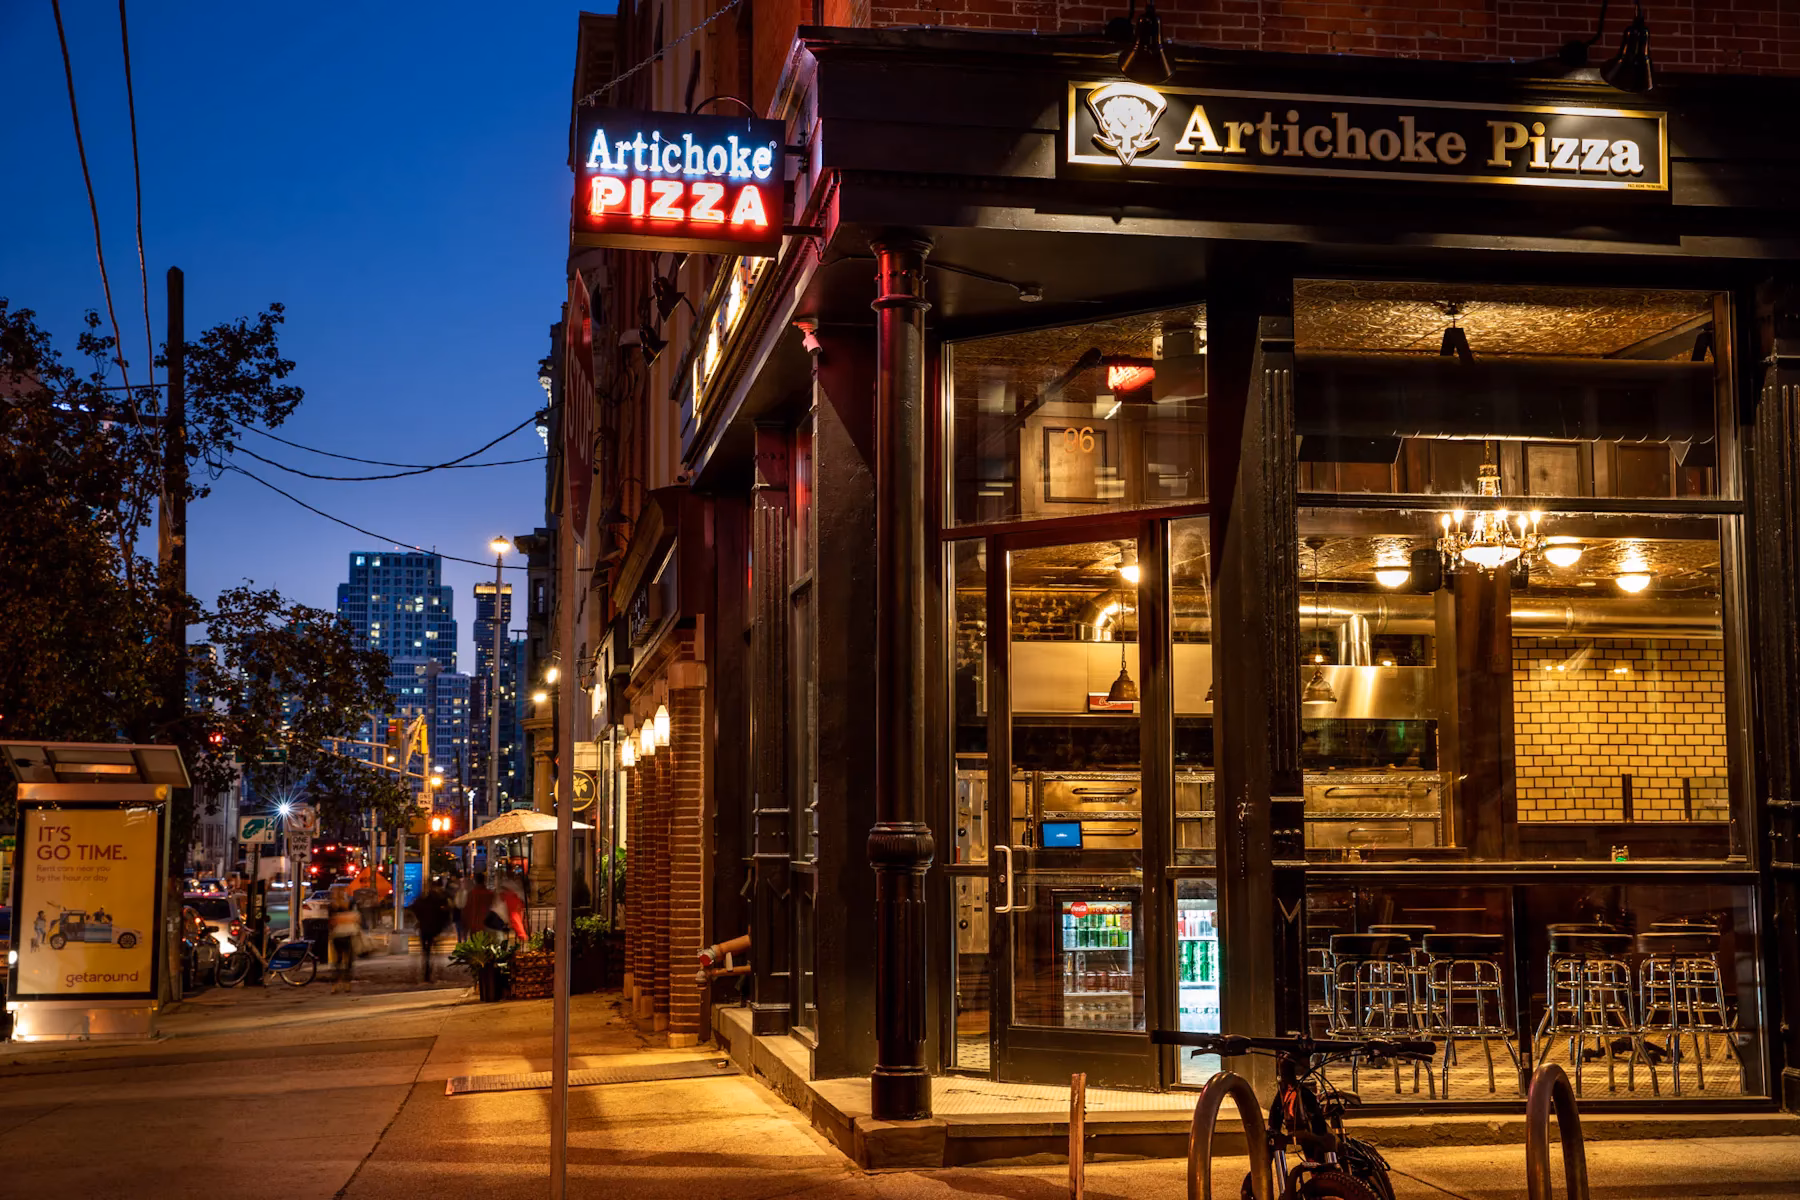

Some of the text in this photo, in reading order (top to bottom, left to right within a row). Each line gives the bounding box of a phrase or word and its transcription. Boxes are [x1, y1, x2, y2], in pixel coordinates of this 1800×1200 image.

[1175, 104, 1645, 176] Artichoke Pizza
[586, 128, 774, 179] Artichoke
[591, 175, 769, 227] PIZZA
[567, 346, 593, 466] STOP
[1063, 426, 1095, 453] 96
[38, 826, 72, 842] IT'S
[36, 844, 128, 861] GO TIME.
[36, 864, 111, 875] Rent cars near you
[36, 874, 45, 883] by
[47, 874, 61, 882] the
[63, 874, 81, 882] hour
[93, 874, 108, 883] day
[65, 970, 139, 988] getaround
